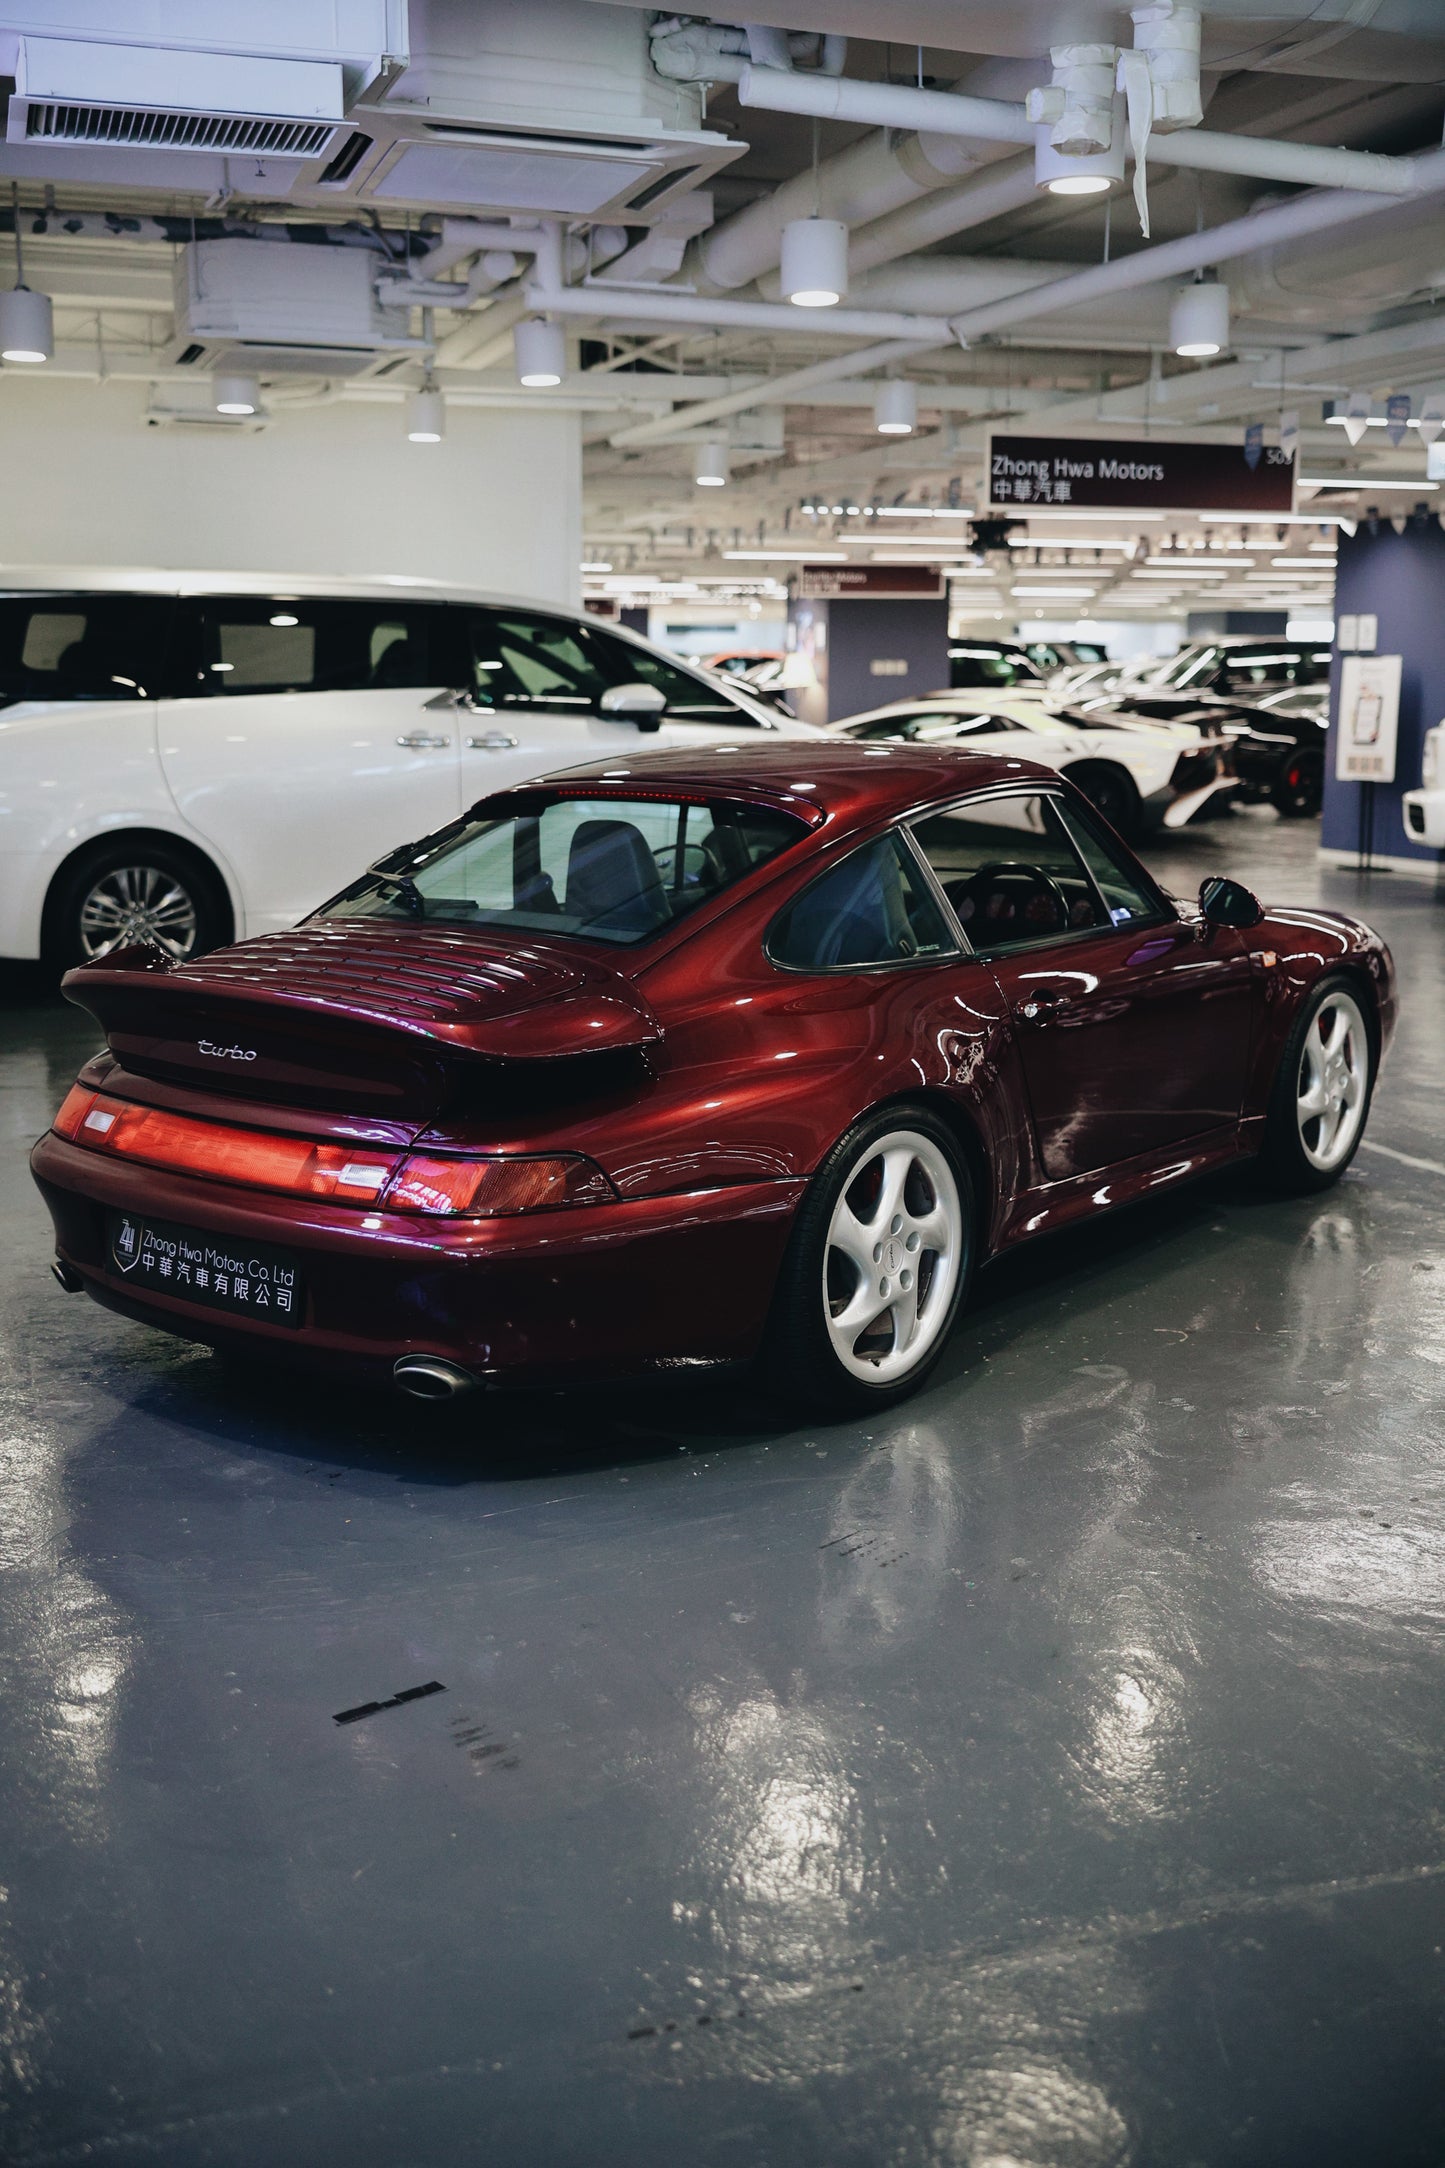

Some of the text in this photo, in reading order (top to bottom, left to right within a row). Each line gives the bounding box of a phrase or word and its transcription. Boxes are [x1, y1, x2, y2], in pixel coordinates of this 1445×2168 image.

[992, 454, 1164, 482] Zhong Hwa Motors
[993, 479, 1072, 502] 中華汽車
[198, 1040, 257, 1061] turbo
[143, 1229, 176, 1257] Zhong
[179, 1240, 202, 1262] Hwa
[205, 1247, 245, 1274] Motors
[248, 1259, 270, 1281] Co.
[274, 1265, 295, 1287] Ltd
[142, 1251, 292, 1312] 中華汽車有限公司
